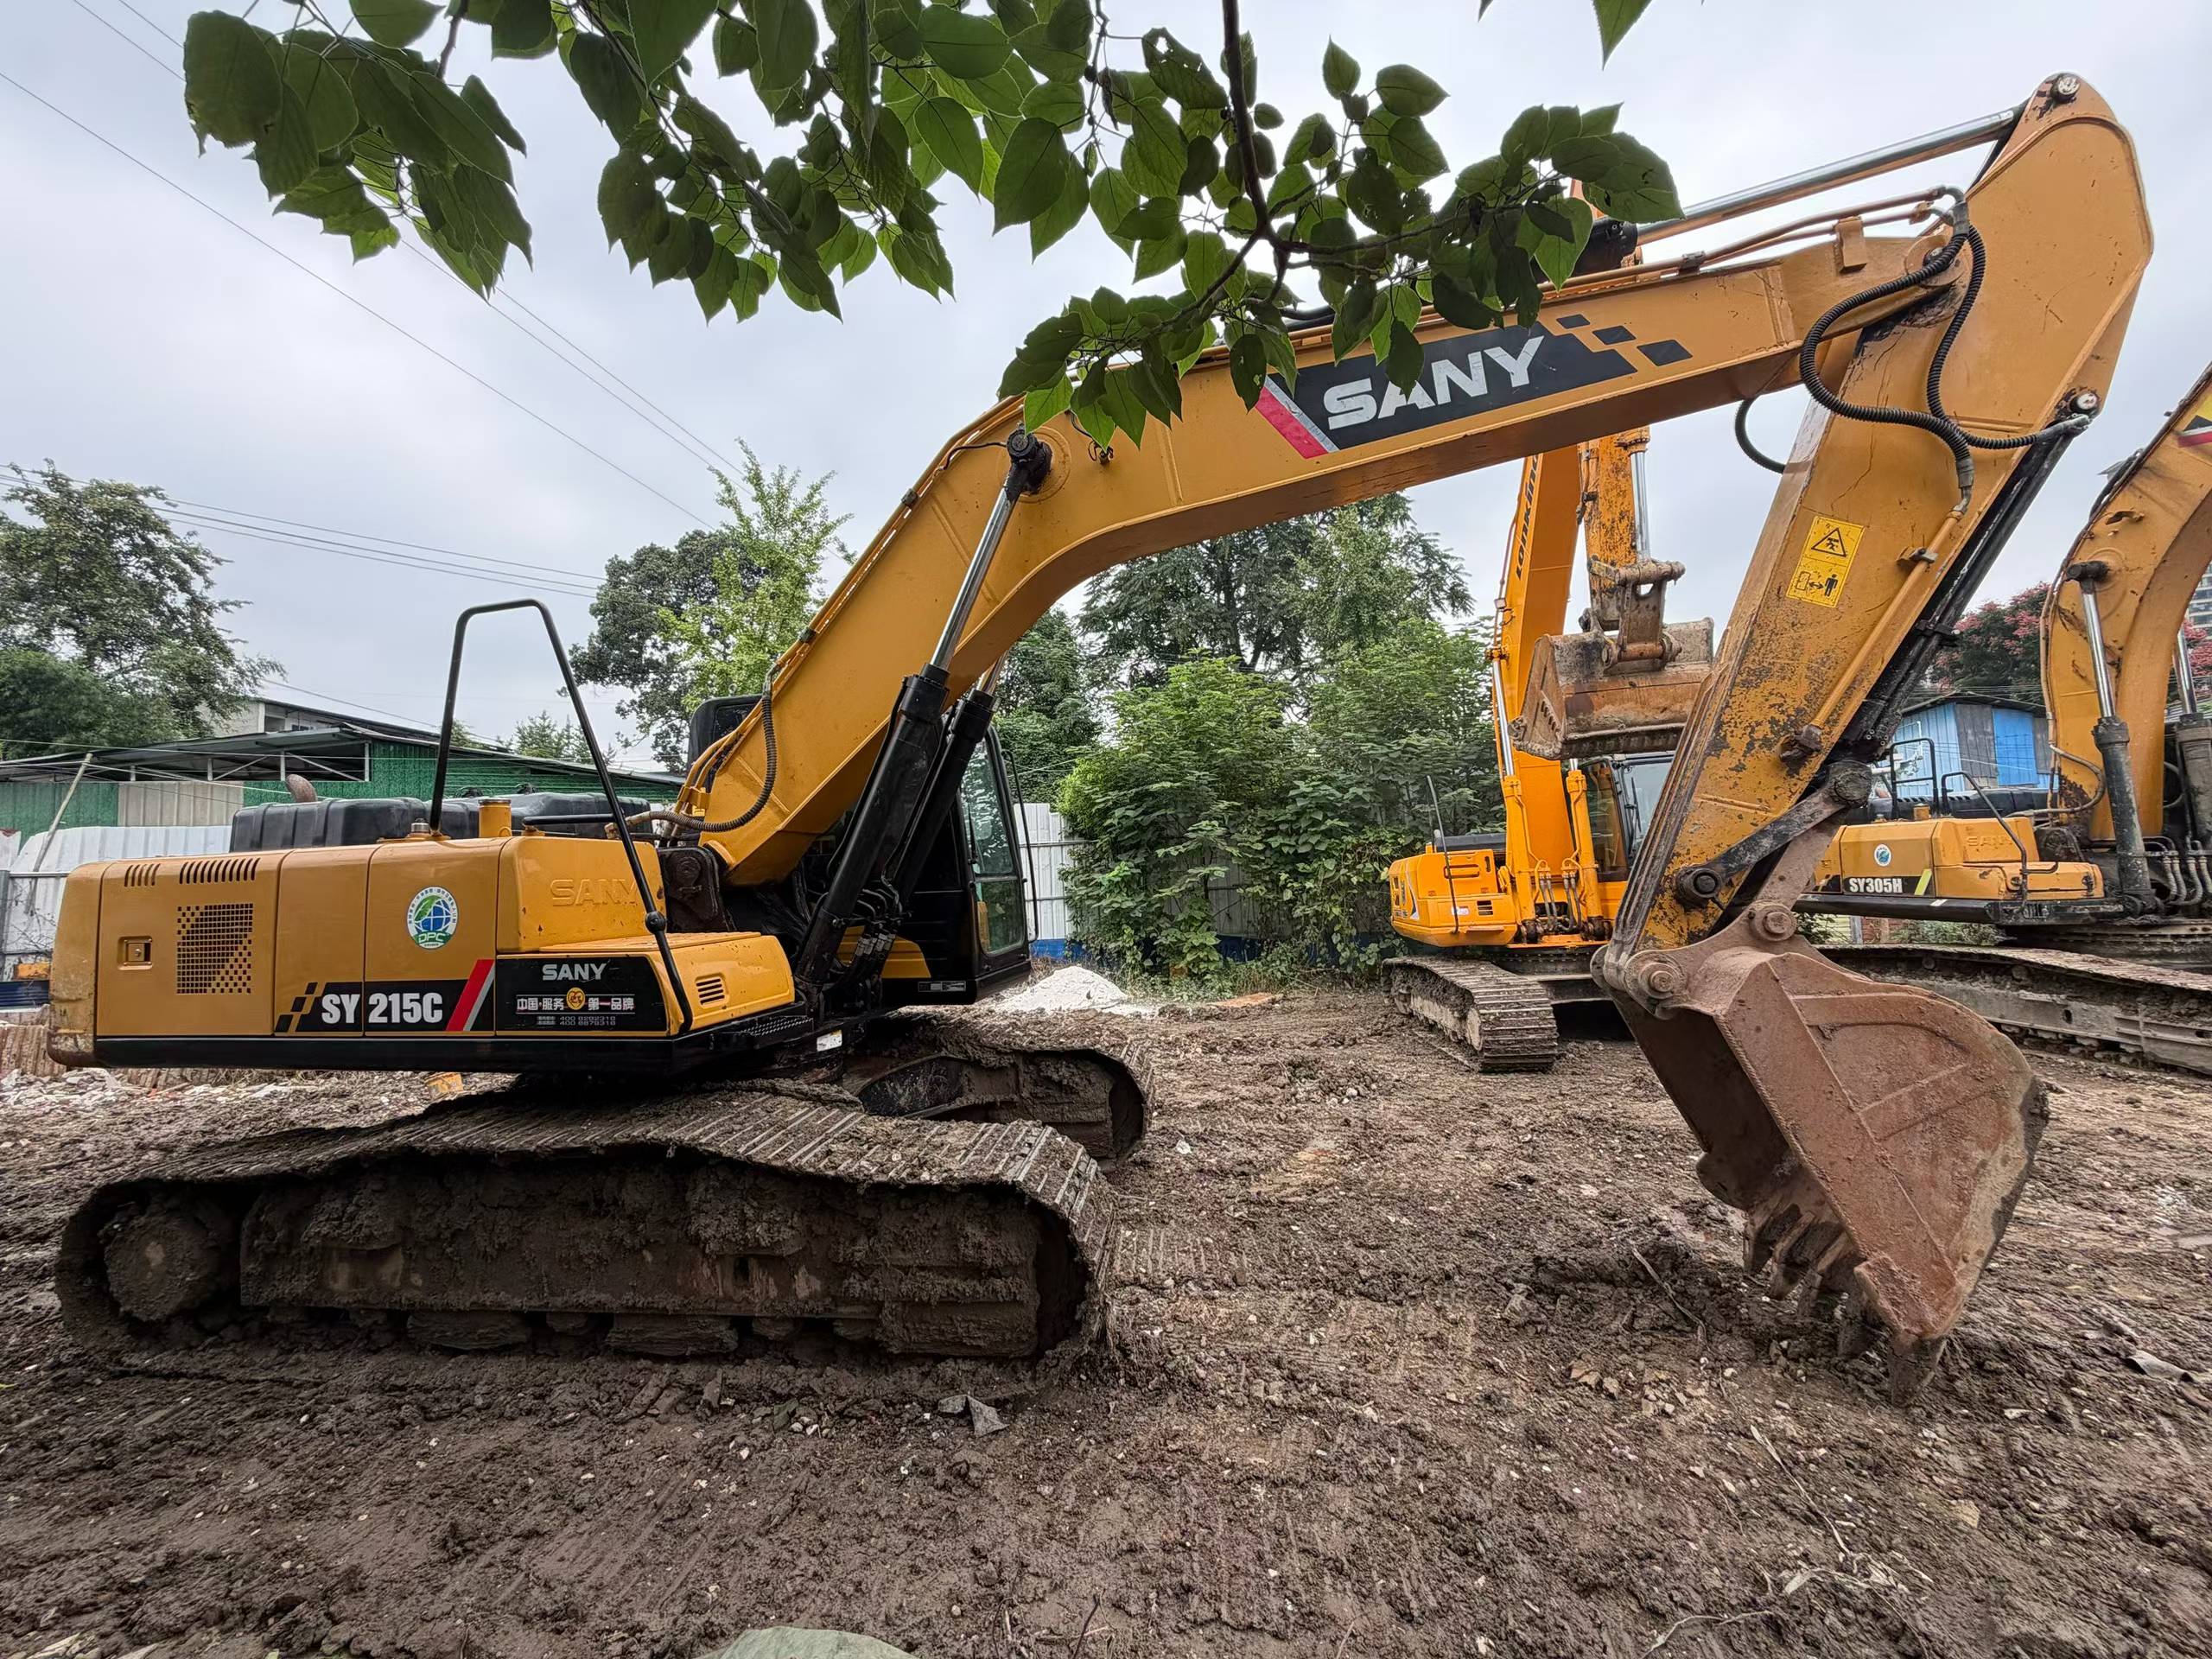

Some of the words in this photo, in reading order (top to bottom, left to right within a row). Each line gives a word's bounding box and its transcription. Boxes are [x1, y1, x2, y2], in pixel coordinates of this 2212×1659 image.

[1324, 335, 1545, 430] SANY
[1848, 877, 1903, 893] SY305H
[418, 931, 446, 944] DPC
[542, 963, 607, 982] SANY
[321, 994, 360, 1024] SY
[368, 993, 442, 1024] 215C
